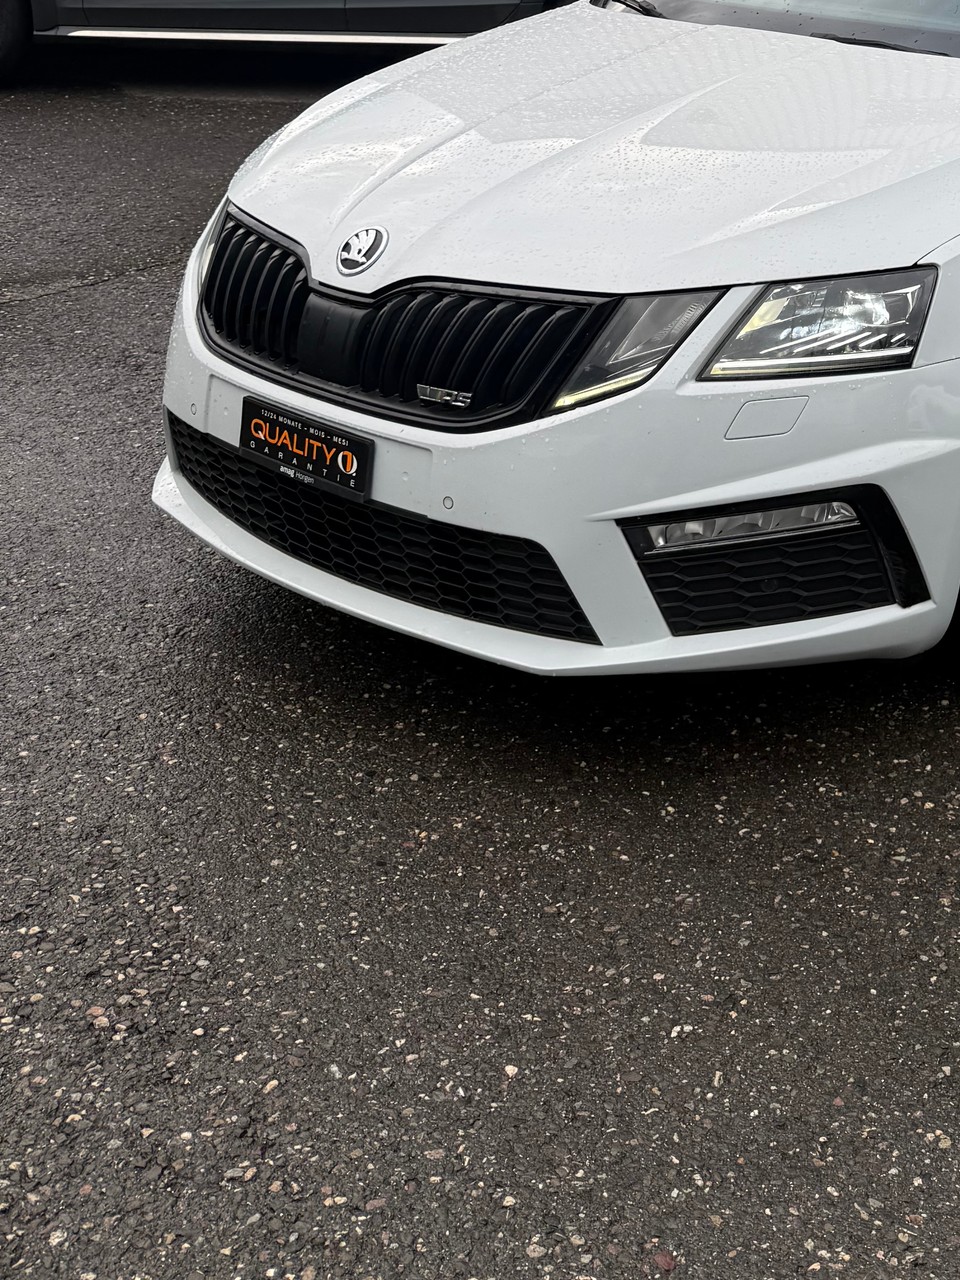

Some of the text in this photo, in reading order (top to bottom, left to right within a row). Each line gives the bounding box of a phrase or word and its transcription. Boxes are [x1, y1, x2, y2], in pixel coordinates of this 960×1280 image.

[250, 418, 337, 466] QUALITY
[261, 409, 277, 420] 12/24
[278, 416, 302, 430] MONATE
[309, 427, 325, 438] MOIS
[333, 436, 349, 447] MESI
[250, 440, 355, 487] GARANTIE
[279, 465, 315, 485] amag Horgen
